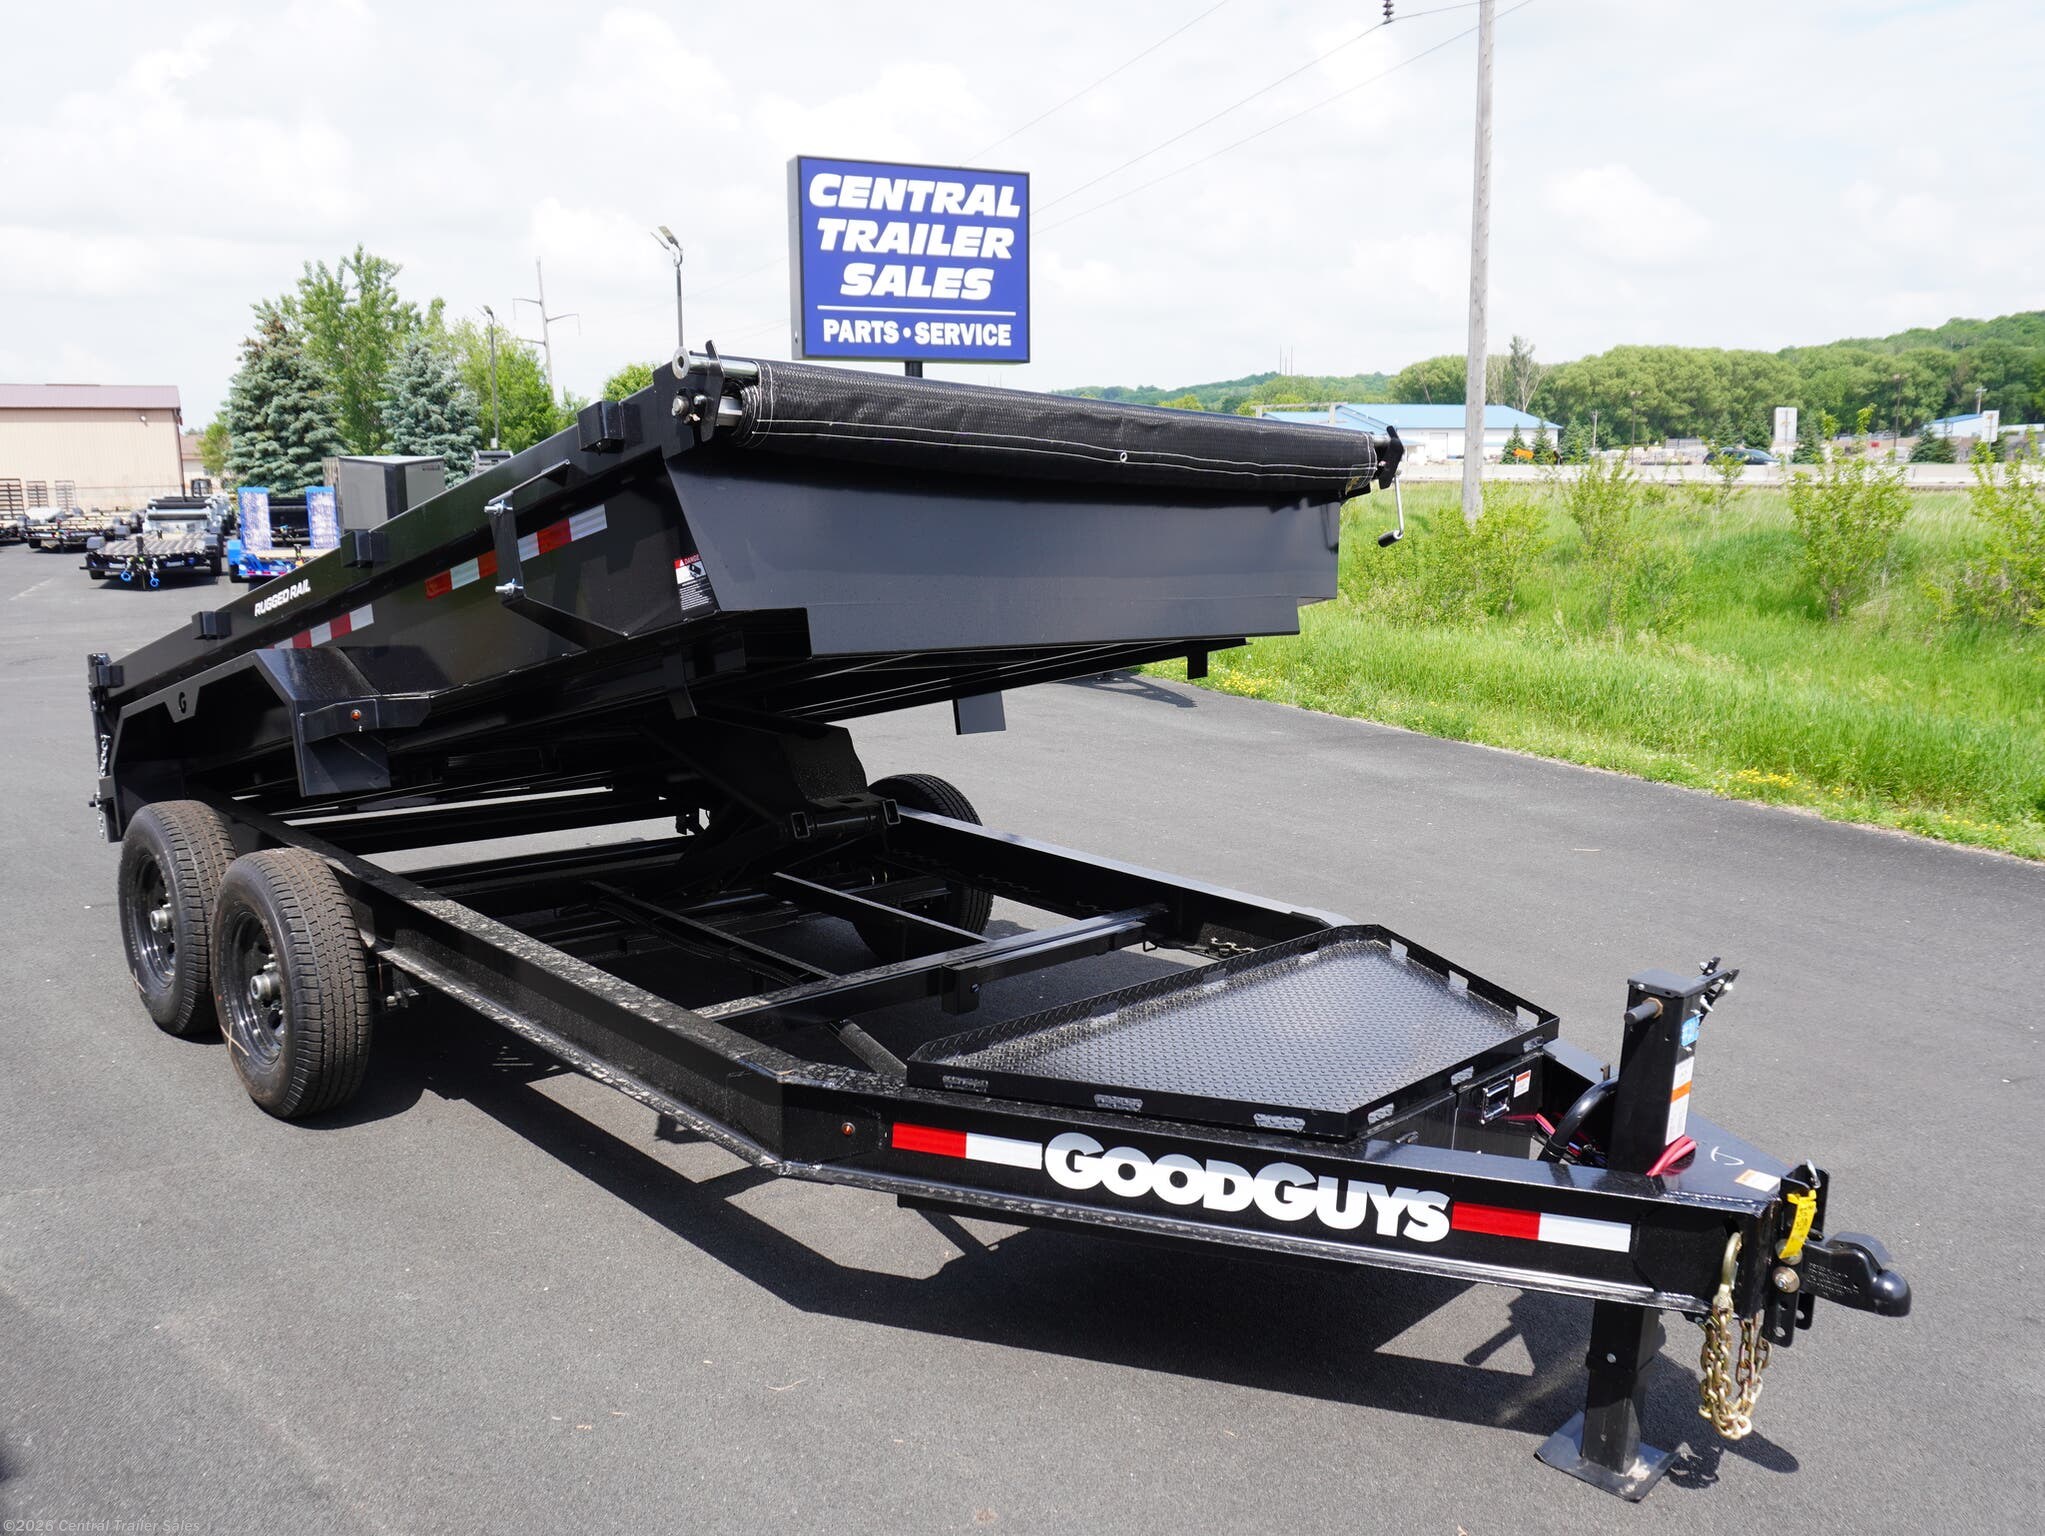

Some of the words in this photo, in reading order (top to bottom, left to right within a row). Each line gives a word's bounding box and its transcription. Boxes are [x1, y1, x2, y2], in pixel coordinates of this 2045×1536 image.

[809, 173, 1021, 218] CENTRAL
[817, 217, 1015, 259] TRAILER
[840, 262, 995, 300] SALES
[823, 319, 900, 344] PARTS
[914, 321, 1012, 346] SERVICE
[254, 588, 289, 616] RUGGED
[290, 579, 311, 599] RAIL
[1045, 1132, 1450, 1243] GOODGUYS
